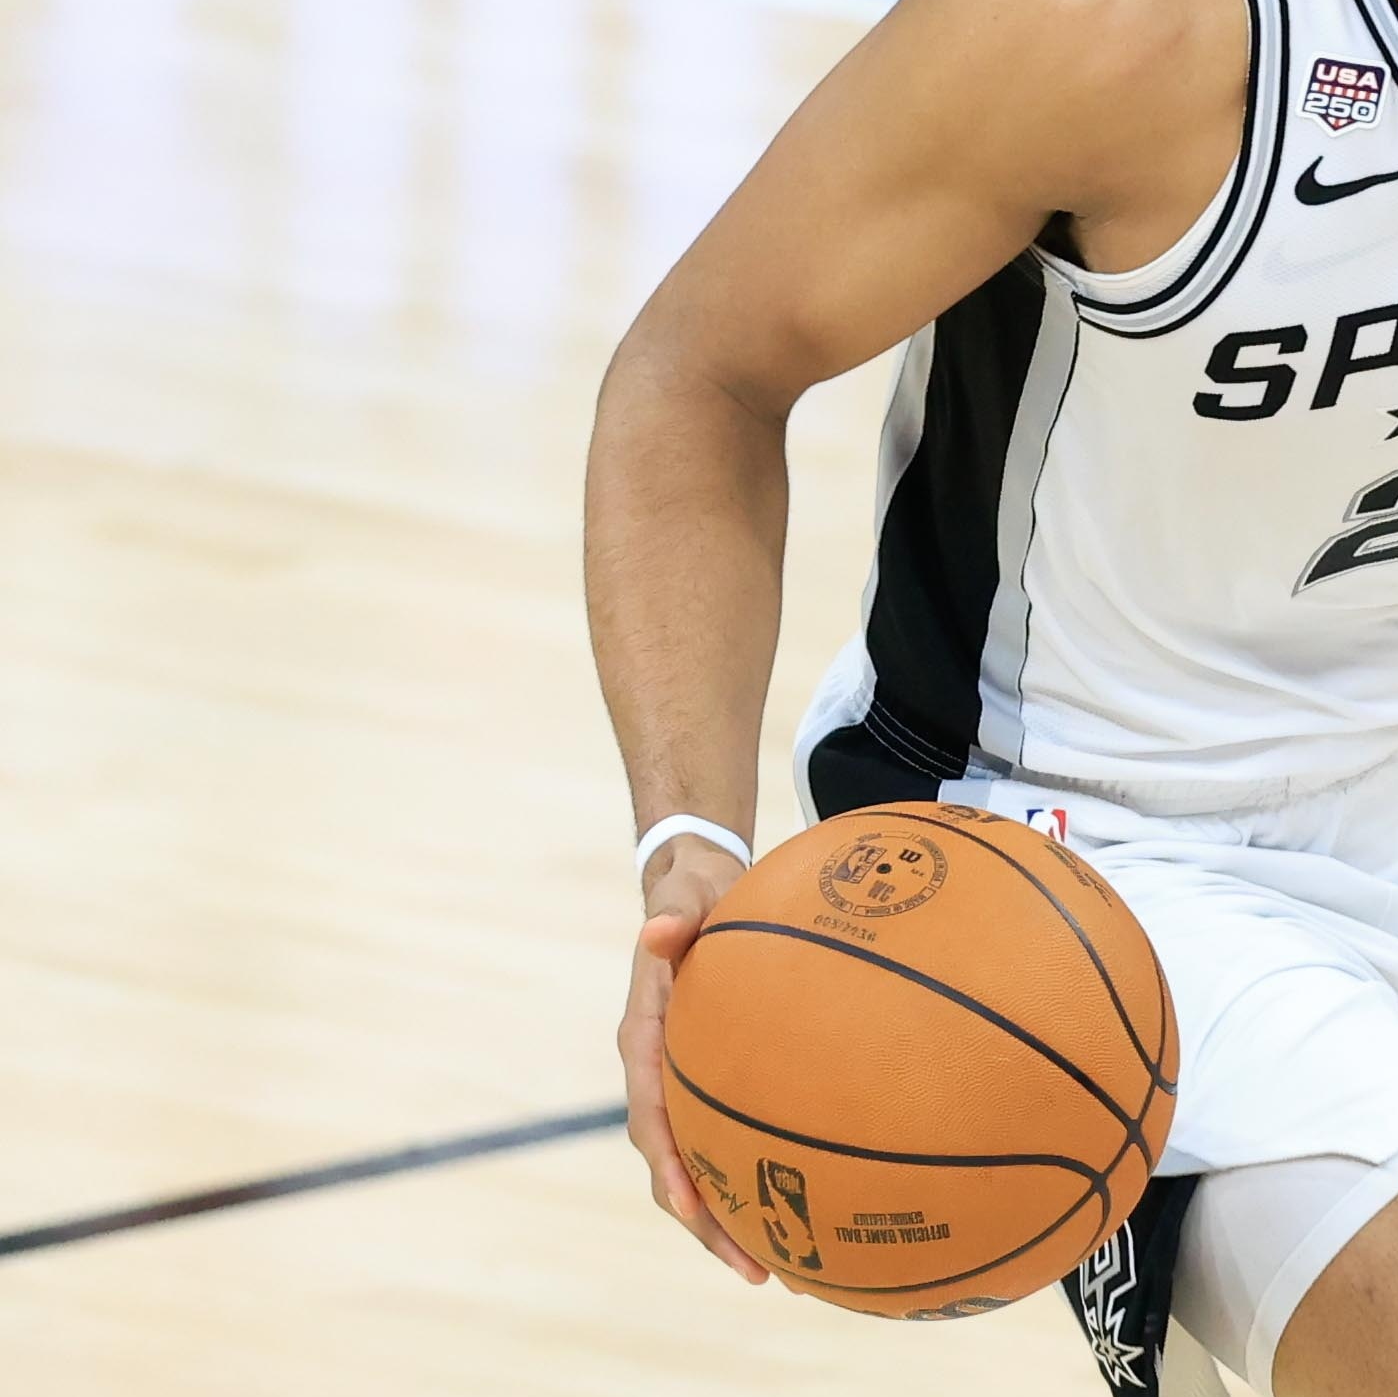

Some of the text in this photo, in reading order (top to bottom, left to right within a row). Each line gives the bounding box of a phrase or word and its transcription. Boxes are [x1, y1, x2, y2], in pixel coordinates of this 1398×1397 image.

[1315, 63, 1379, 89] USA
[1303, 92, 1377, 123] 250
[834, 1223, 951, 1244] OFFICIAL GAME BALL
